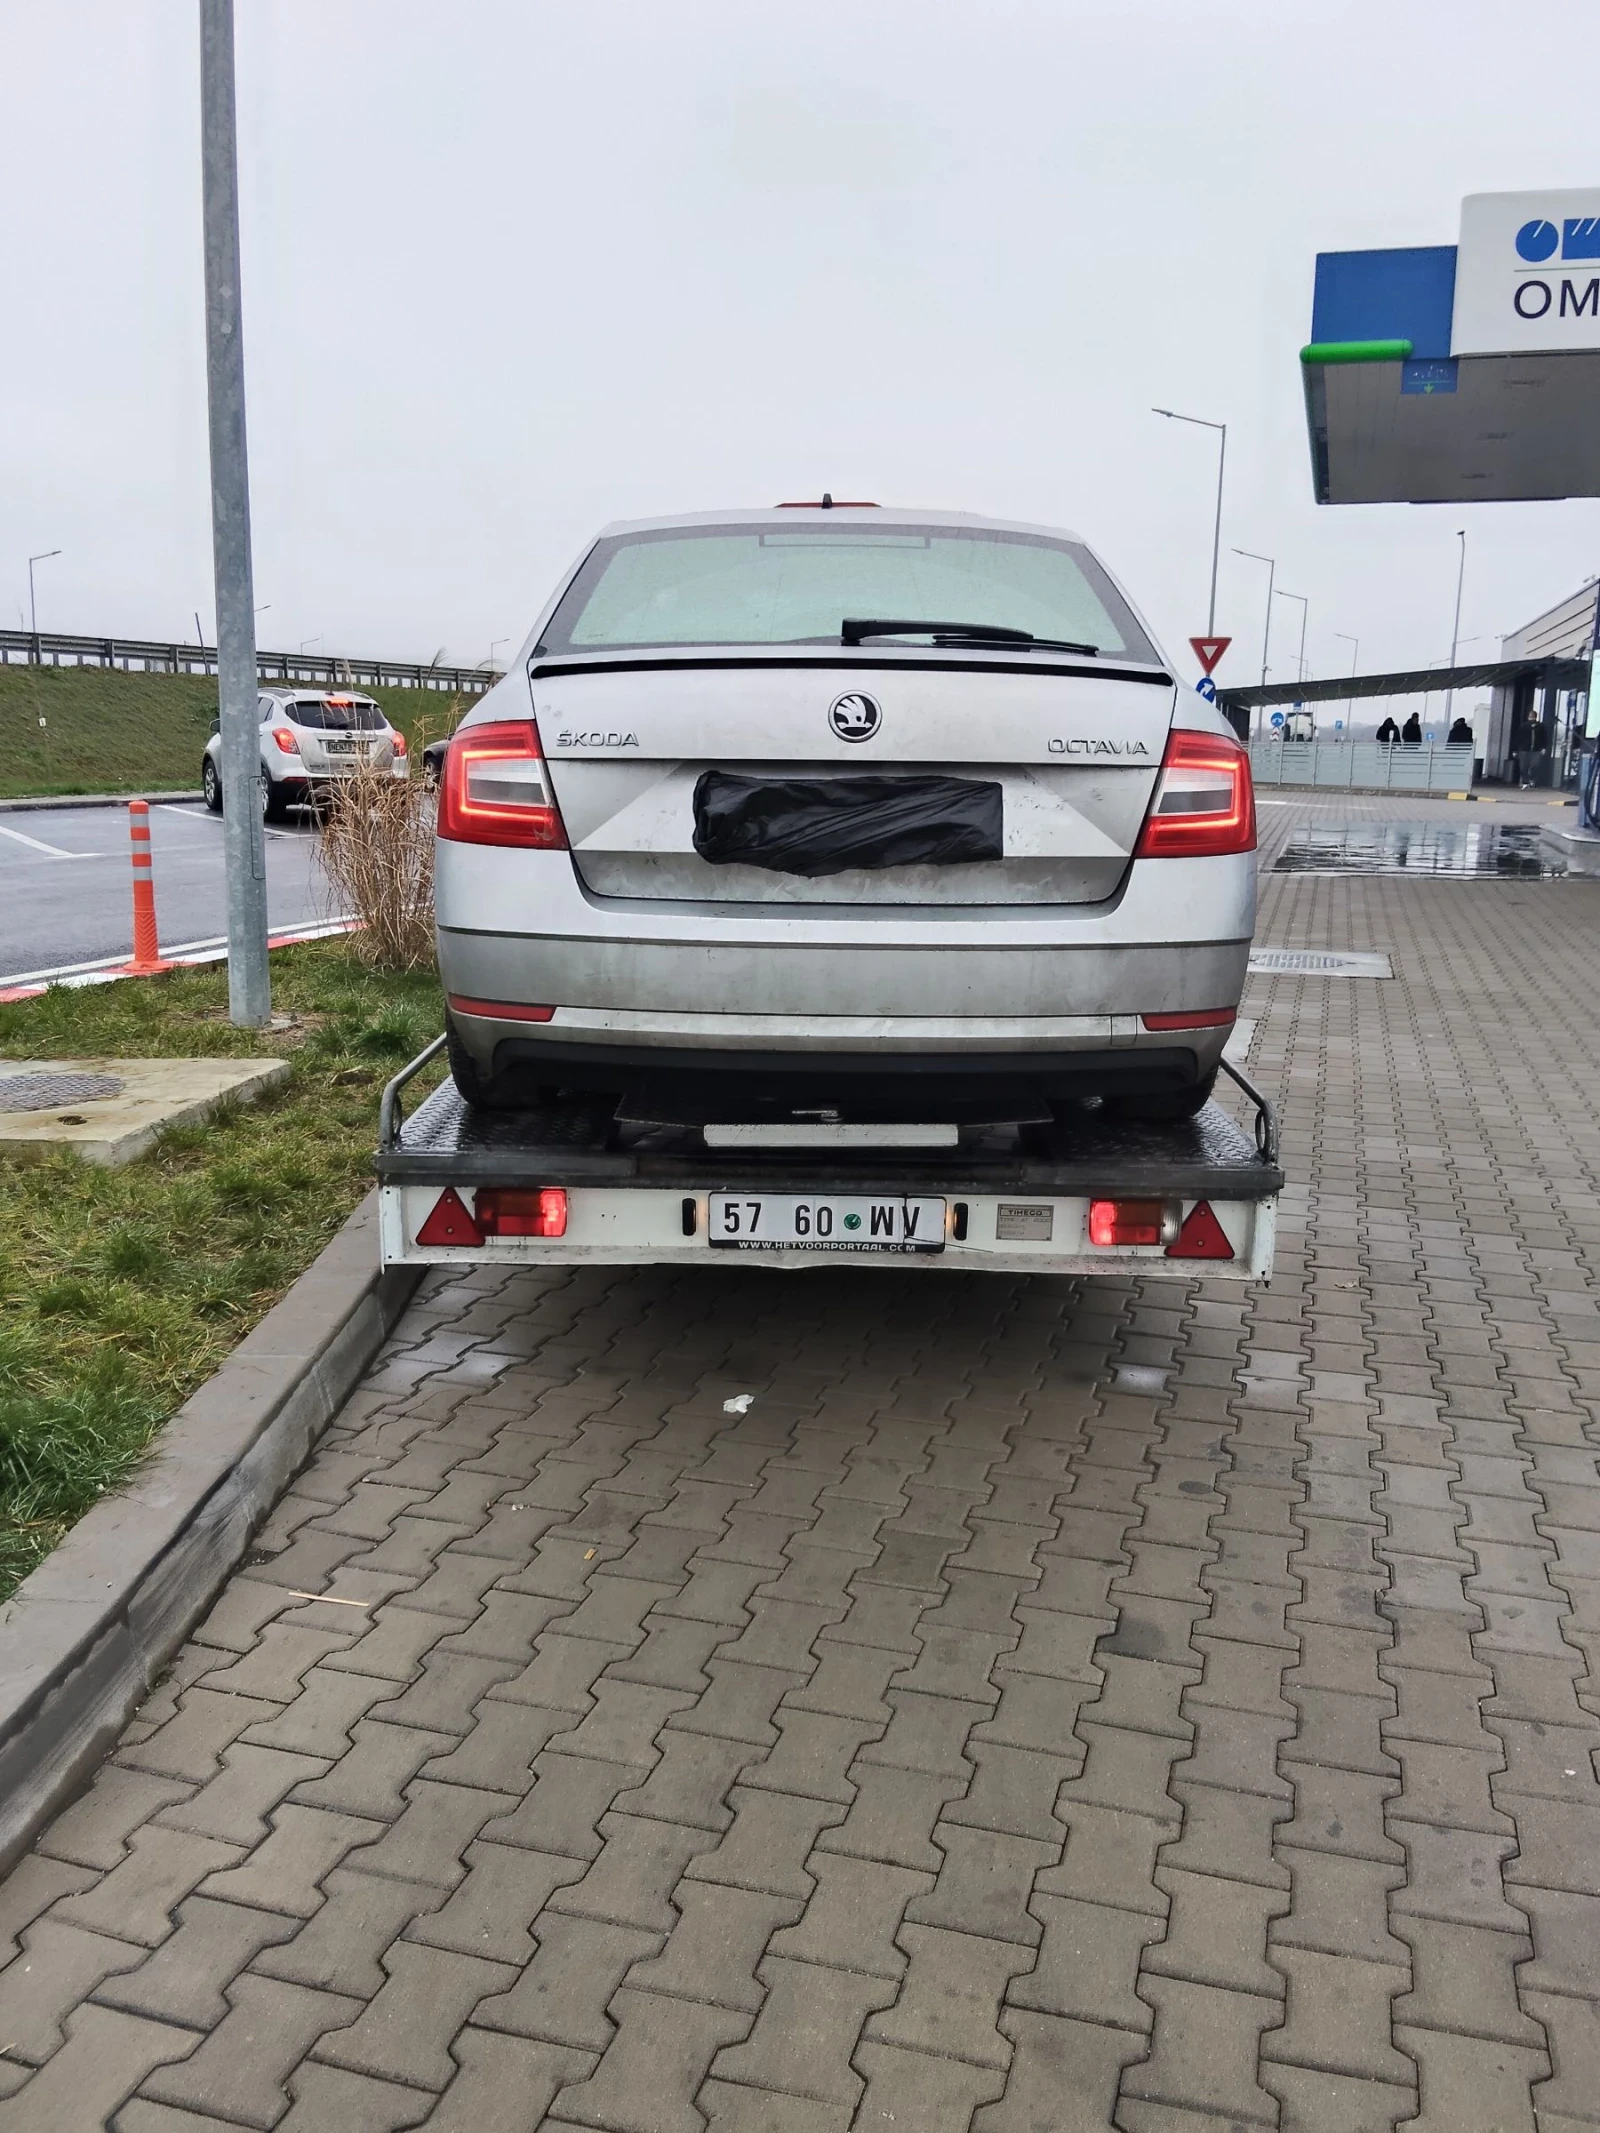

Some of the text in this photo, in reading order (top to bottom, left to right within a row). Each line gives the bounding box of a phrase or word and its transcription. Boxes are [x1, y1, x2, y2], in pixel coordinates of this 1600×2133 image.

[1514, 278, 1600, 319] OM
[556, 729, 640, 747] ŠKODA
[1047, 739, 1149, 754] OCTAVIA
[724, 1202, 762, 1234] 57
[795, 1204, 833, 1237] 60
